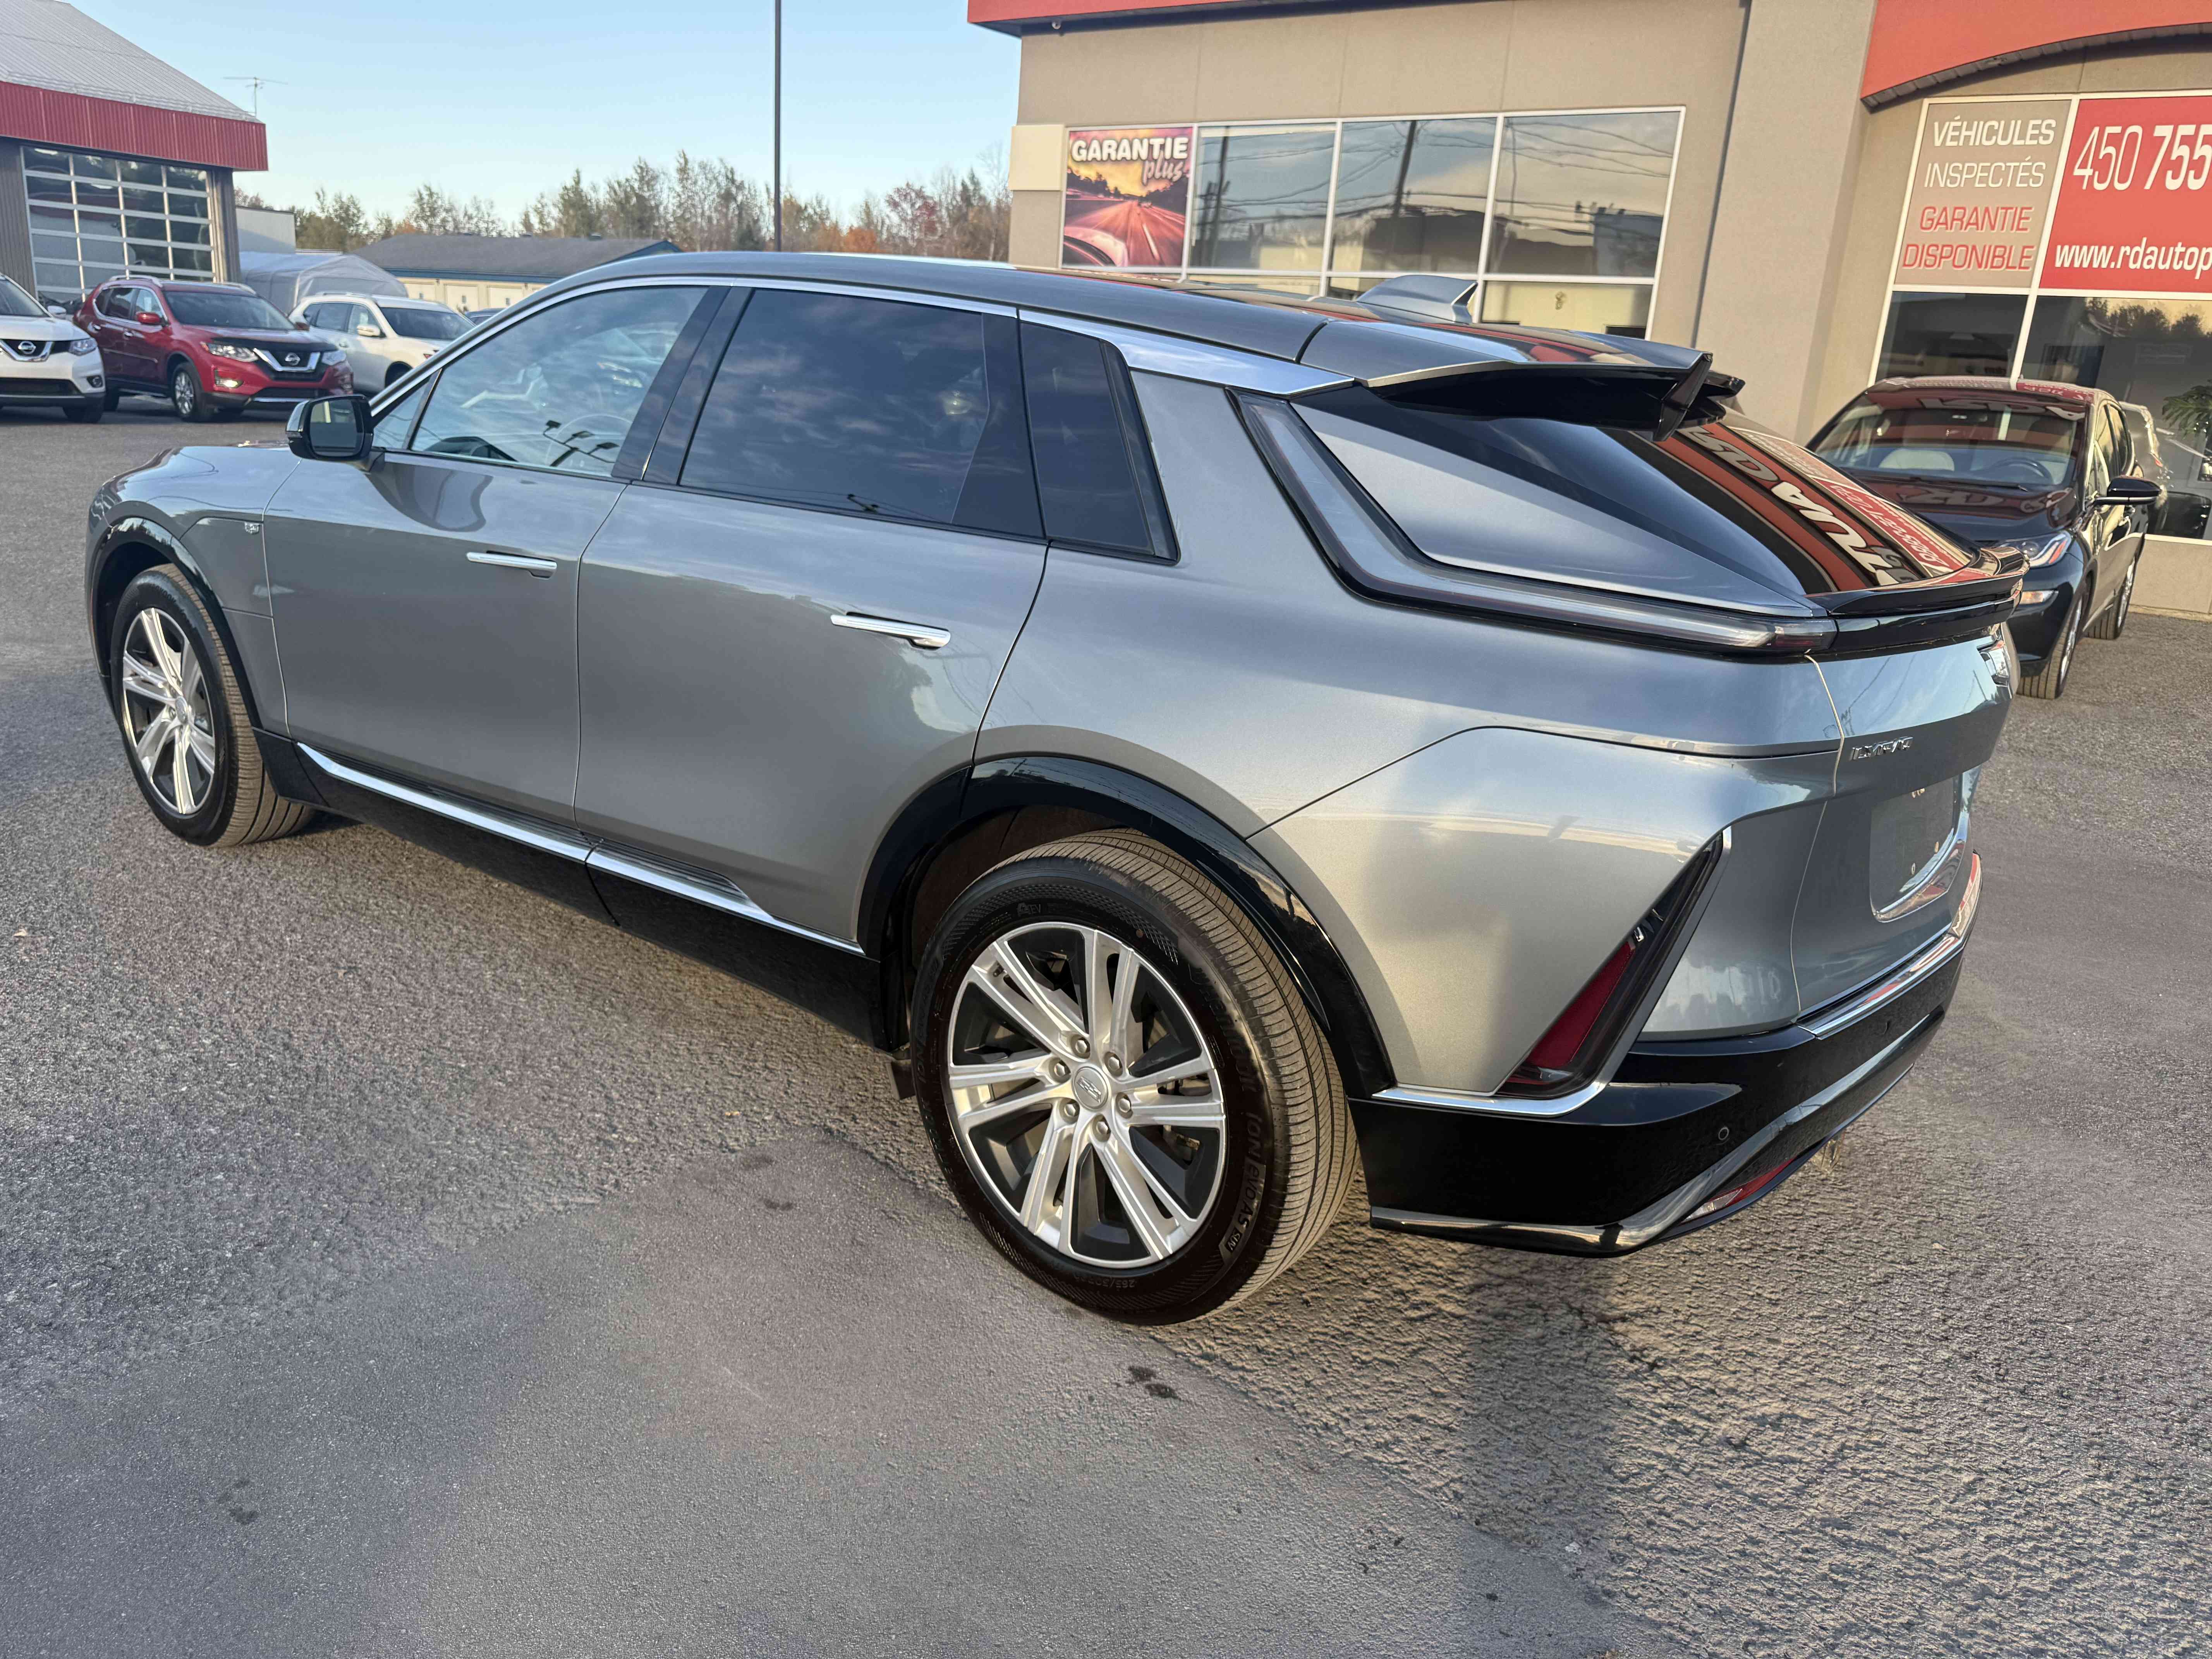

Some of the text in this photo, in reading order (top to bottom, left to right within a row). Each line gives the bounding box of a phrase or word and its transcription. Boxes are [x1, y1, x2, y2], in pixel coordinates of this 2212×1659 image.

[1934, 115, 2056, 146] VÉHICULES
[1071, 136, 1189, 162] GARANTIE
[2073, 124, 2212, 191] 450 755
[1142, 151, 1183, 185] plus
[1924, 156, 2046, 187] INSPECTÉS
[1920, 206, 2034, 232] GARANTIE
[1902, 244, 2035, 271] DISPONIBLE
[2055, 237, 2212, 280] www.rdautop
